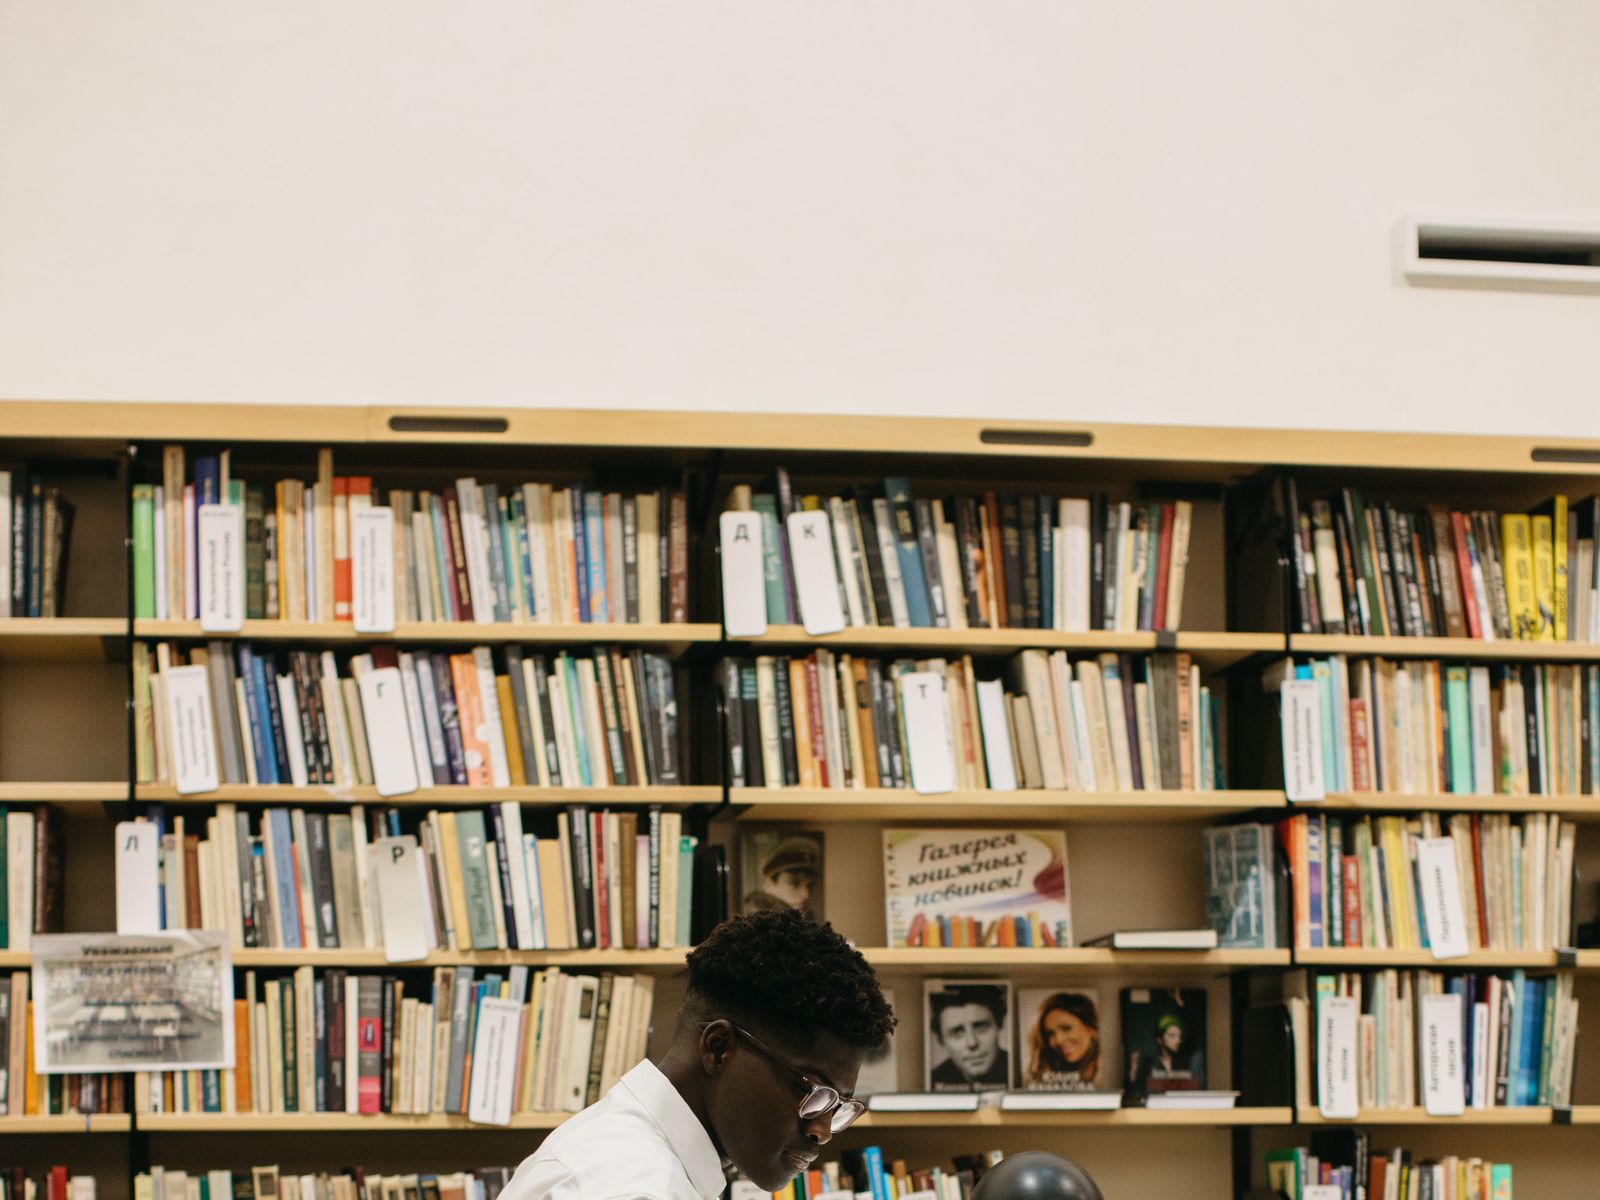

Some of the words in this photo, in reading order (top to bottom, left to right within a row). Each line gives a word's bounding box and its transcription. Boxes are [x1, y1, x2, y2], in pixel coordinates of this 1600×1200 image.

[733, 523, 750, 543] Д
[802, 523, 816, 539] К
[376, 682, 386, 699] Г
[917, 683, 929, 699] Т
[124, 834, 140, 852] Л
[917, 832, 1017, 864] Галерея
[392, 845, 404, 864] Р
[907, 852, 1027, 887] книжных
[914, 869, 1023, 907] новинок!
[81, 945, 174, 956] Уважаемые
[1429, 1023, 1441, 1093] Авторская
